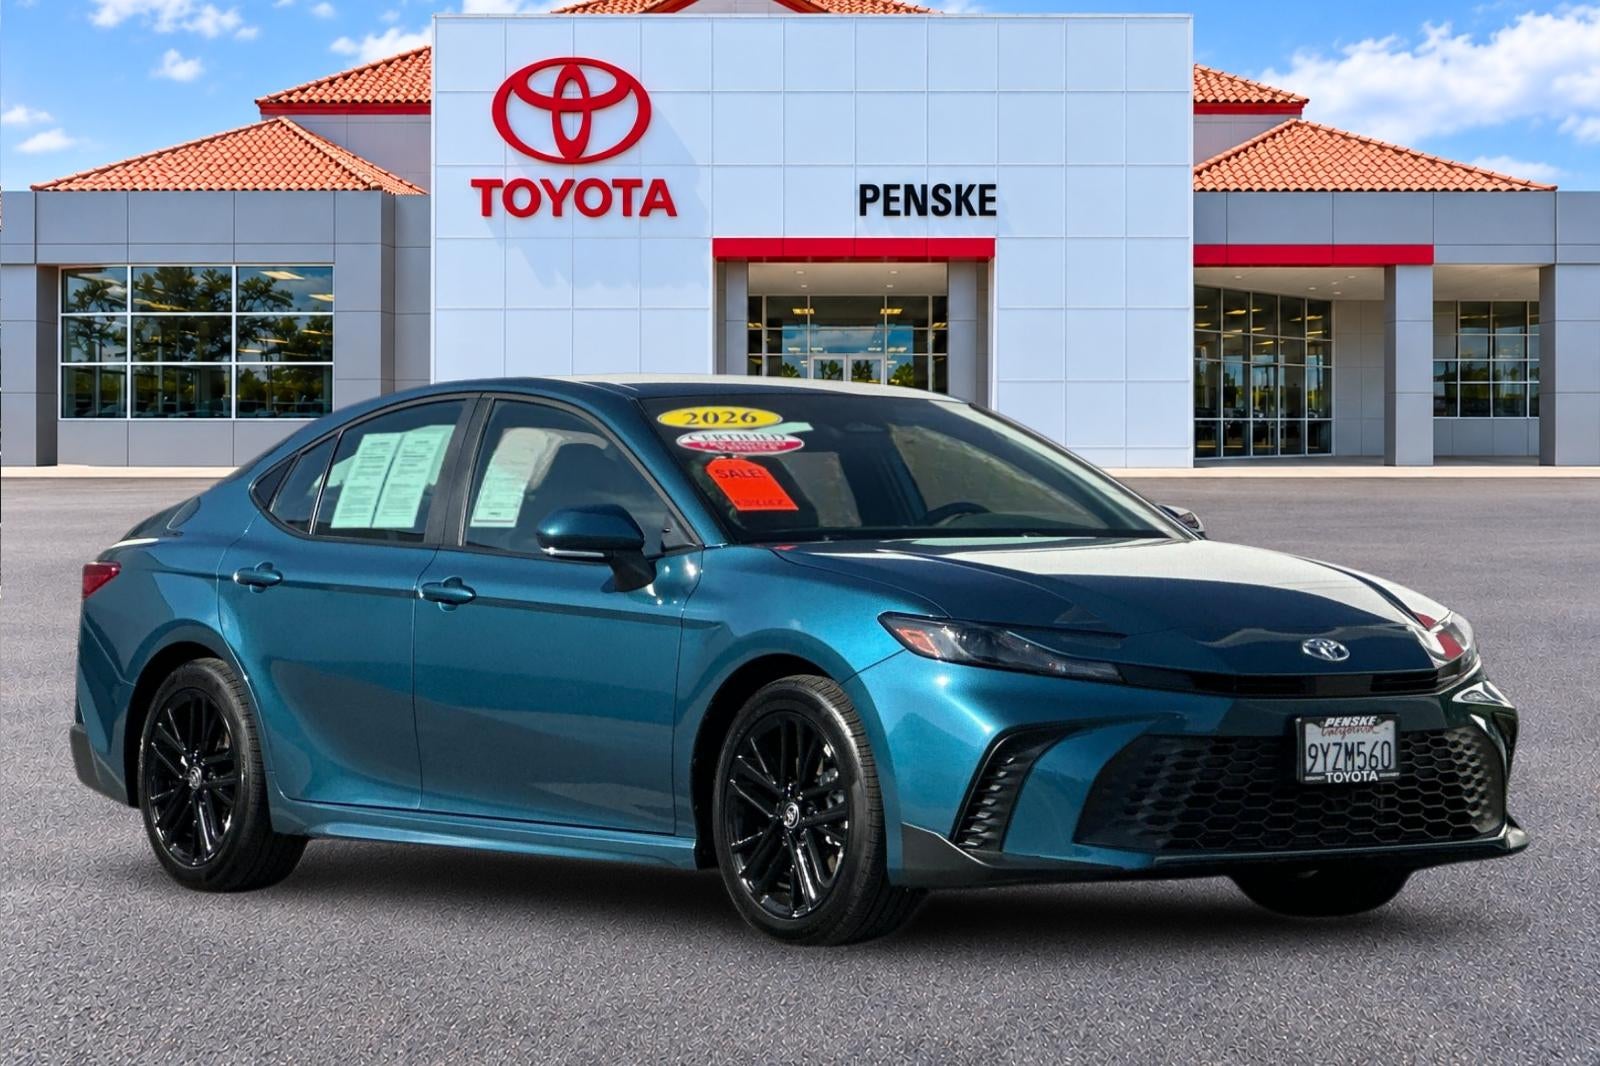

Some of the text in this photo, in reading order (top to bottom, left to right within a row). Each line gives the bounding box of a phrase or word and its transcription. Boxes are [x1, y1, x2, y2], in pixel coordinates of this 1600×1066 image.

[471, 178, 677, 217] TOYOTA
[858, 183, 997, 217] PENSKE
[684, 411, 758, 425] 2026
[688, 432, 785, 442] CERTIFIED
[1325, 716, 1377, 727] PENSKE
[1308, 741, 1392, 773] 9YZM560
[1325, 771, 1378, 783] TOYOTA
